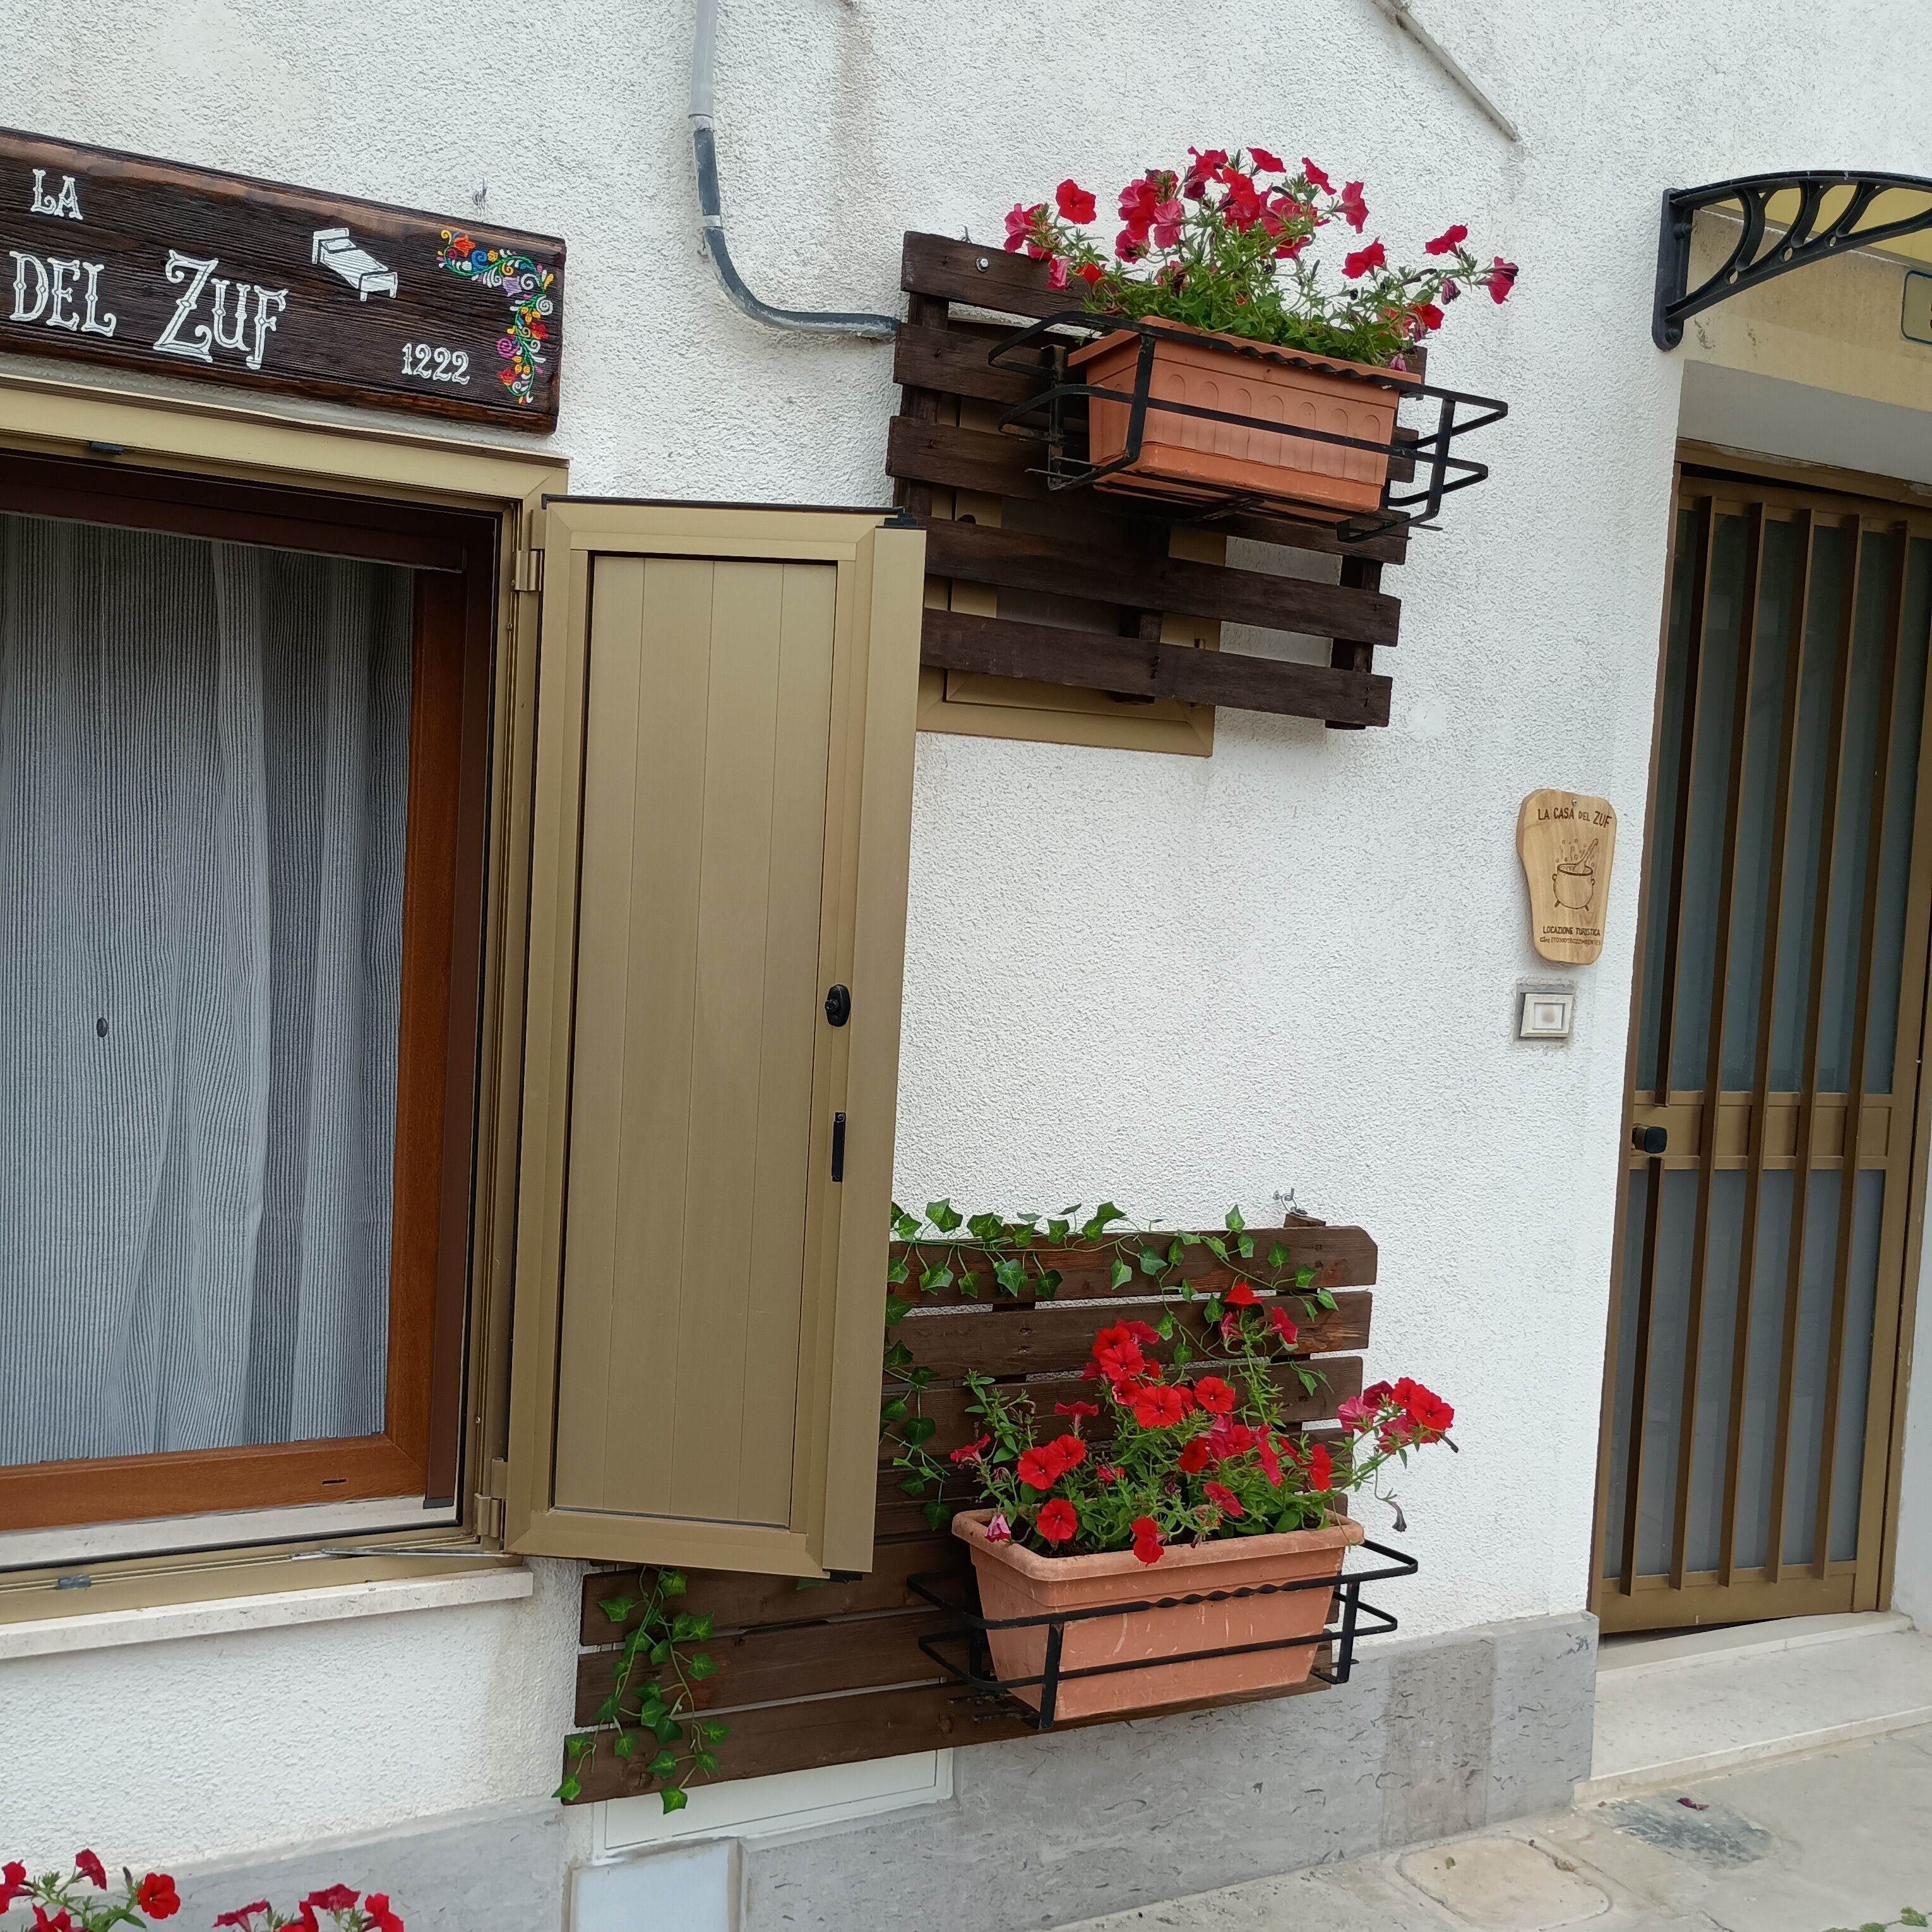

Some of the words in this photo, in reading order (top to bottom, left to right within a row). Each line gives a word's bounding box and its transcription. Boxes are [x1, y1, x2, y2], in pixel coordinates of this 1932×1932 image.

[30, 169, 84, 221] LA
[9, 251, 116, 337] DEL
[401, 343, 470, 385] 1222
[1538, 808, 1550, 820] LA
[1553, 808, 1575, 820] CASA
[1578, 811, 1590, 821] DEL
[1593, 811, 1612, 828] ZUF
[1542, 926, 1573, 934] LOCAZIONE
[1576, 927, 1601, 936] TURISTICA
